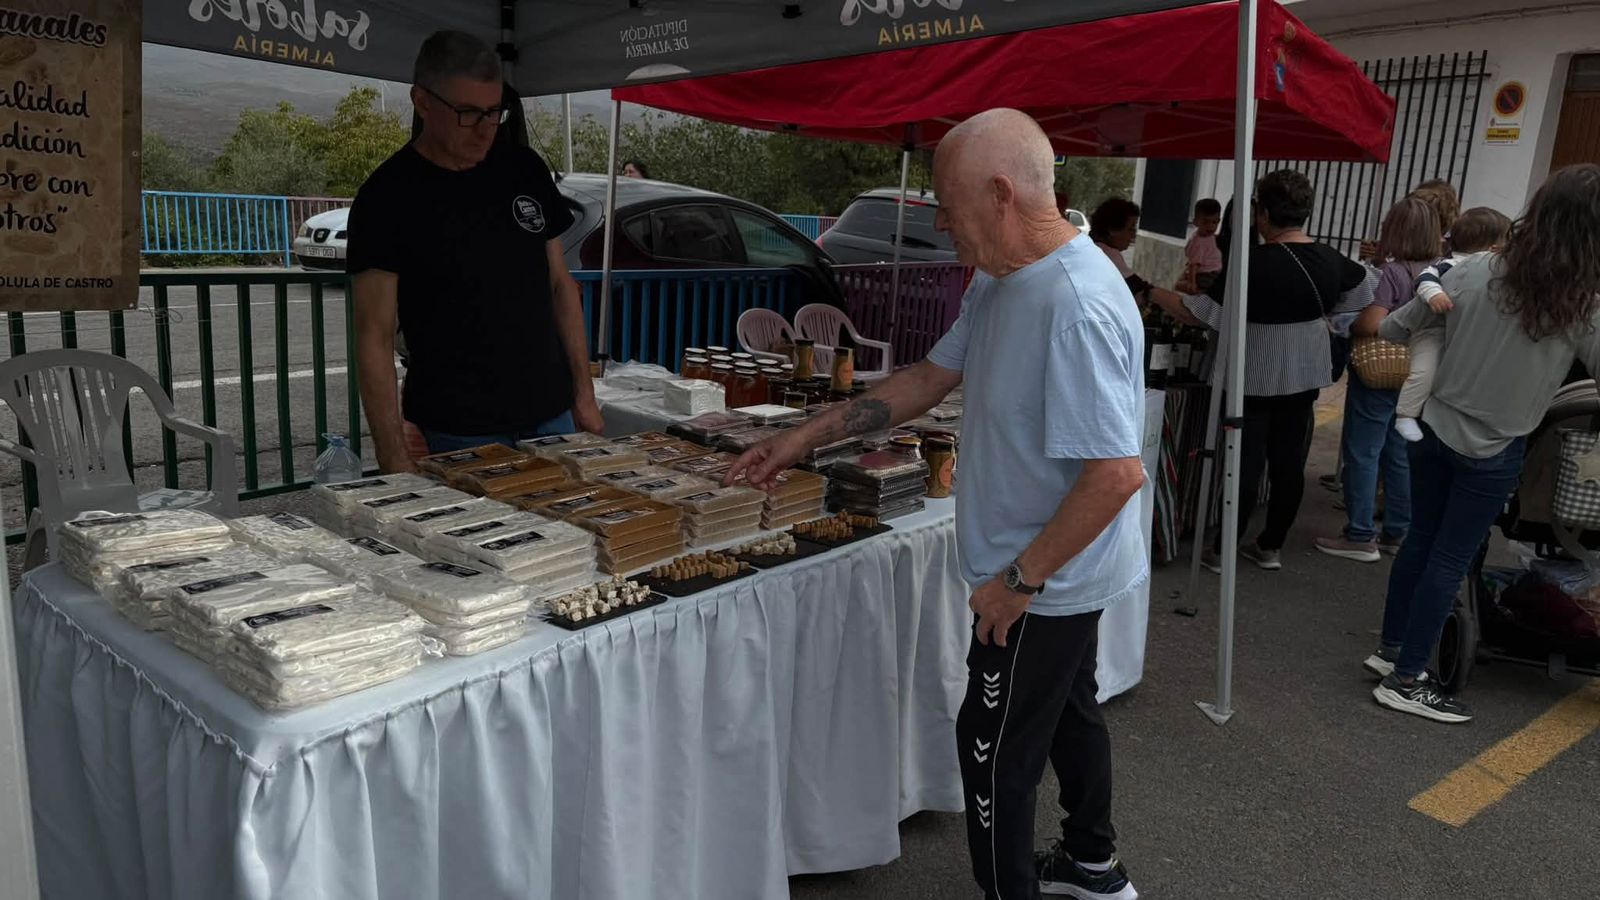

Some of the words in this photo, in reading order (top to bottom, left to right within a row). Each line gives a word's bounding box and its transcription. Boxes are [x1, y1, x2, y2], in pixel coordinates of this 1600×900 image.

[0, 121, 87, 158] dición
[48, 176, 93, 197] con
[44, 277, 61, 288] DE
[65, 278, 113, 289] CASTRO
